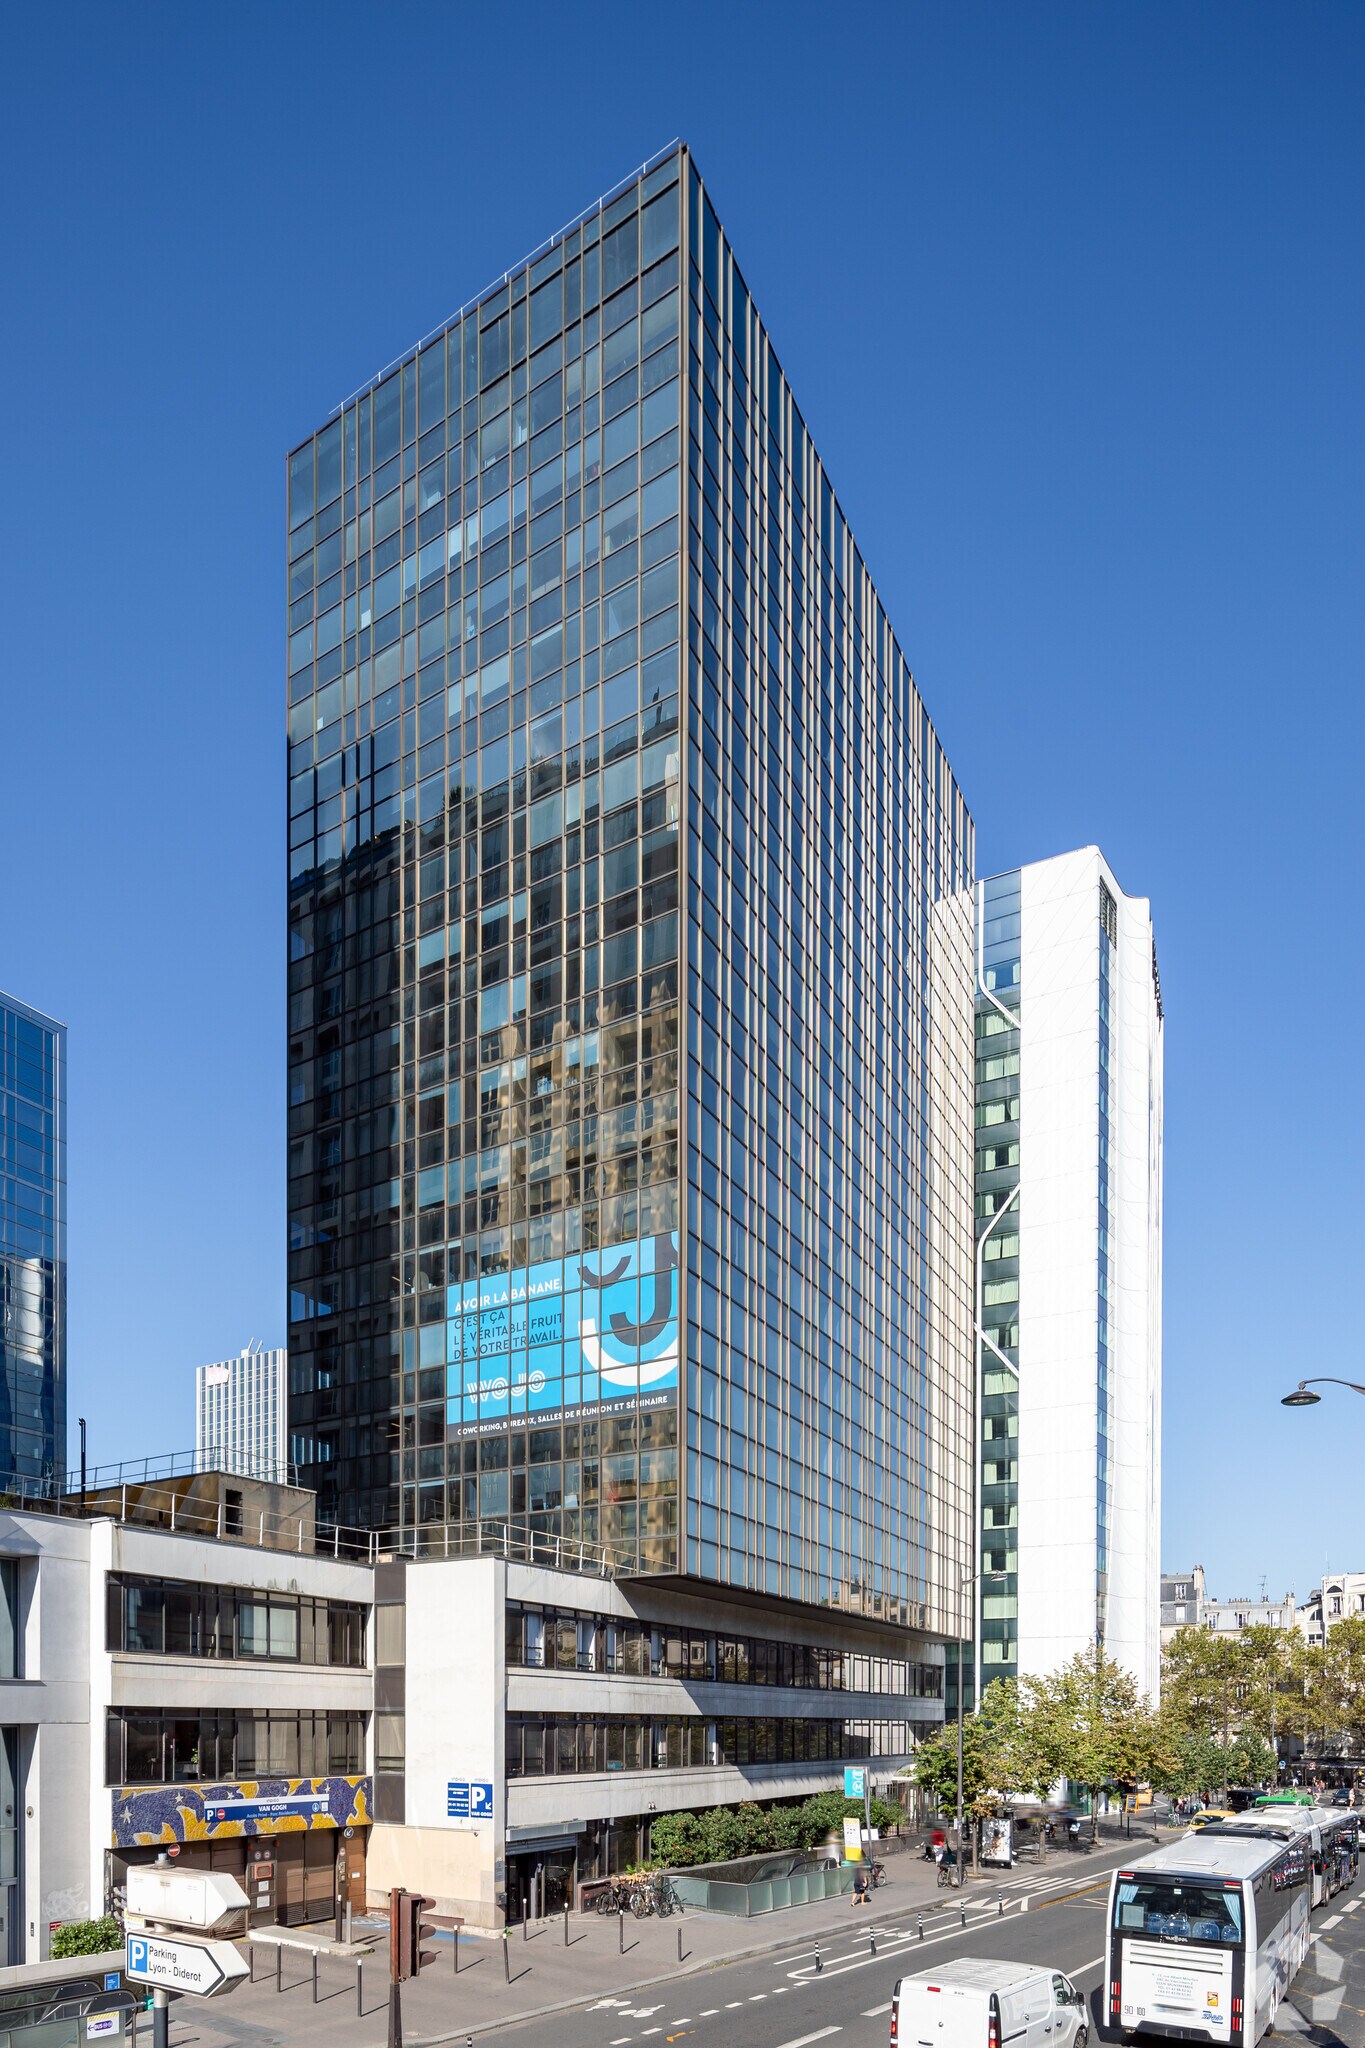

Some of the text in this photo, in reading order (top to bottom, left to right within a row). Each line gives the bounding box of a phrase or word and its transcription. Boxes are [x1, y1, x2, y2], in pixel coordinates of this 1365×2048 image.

[455, 1295, 490, 1312] AVOIR
[494, 1291, 508, 1304] LA
[490, 1310, 505, 1324] ÇA
[454, 1313, 562, 1345] LE VÉRITABLE FRUIT
[454, 1329, 562, 1359] DE VOTRE TRAVAIL.
[538, 1412, 563, 1423] SALLES
[565, 1410, 574, 1418] DE
[614, 1402, 624, 1411] ET
[272, 1804, 287, 1812] GOGH
[471, 1786, 486, 1809] P
[206, 1809, 214, 1820] P
[131, 1941, 145, 1968] P
[149, 1945, 177, 1963] Parking
[148, 1961, 167, 1974] Lyon
[173, 1966, 202, 1982] Diderot
[1124, 2004, 1146, 2016] 90 100
